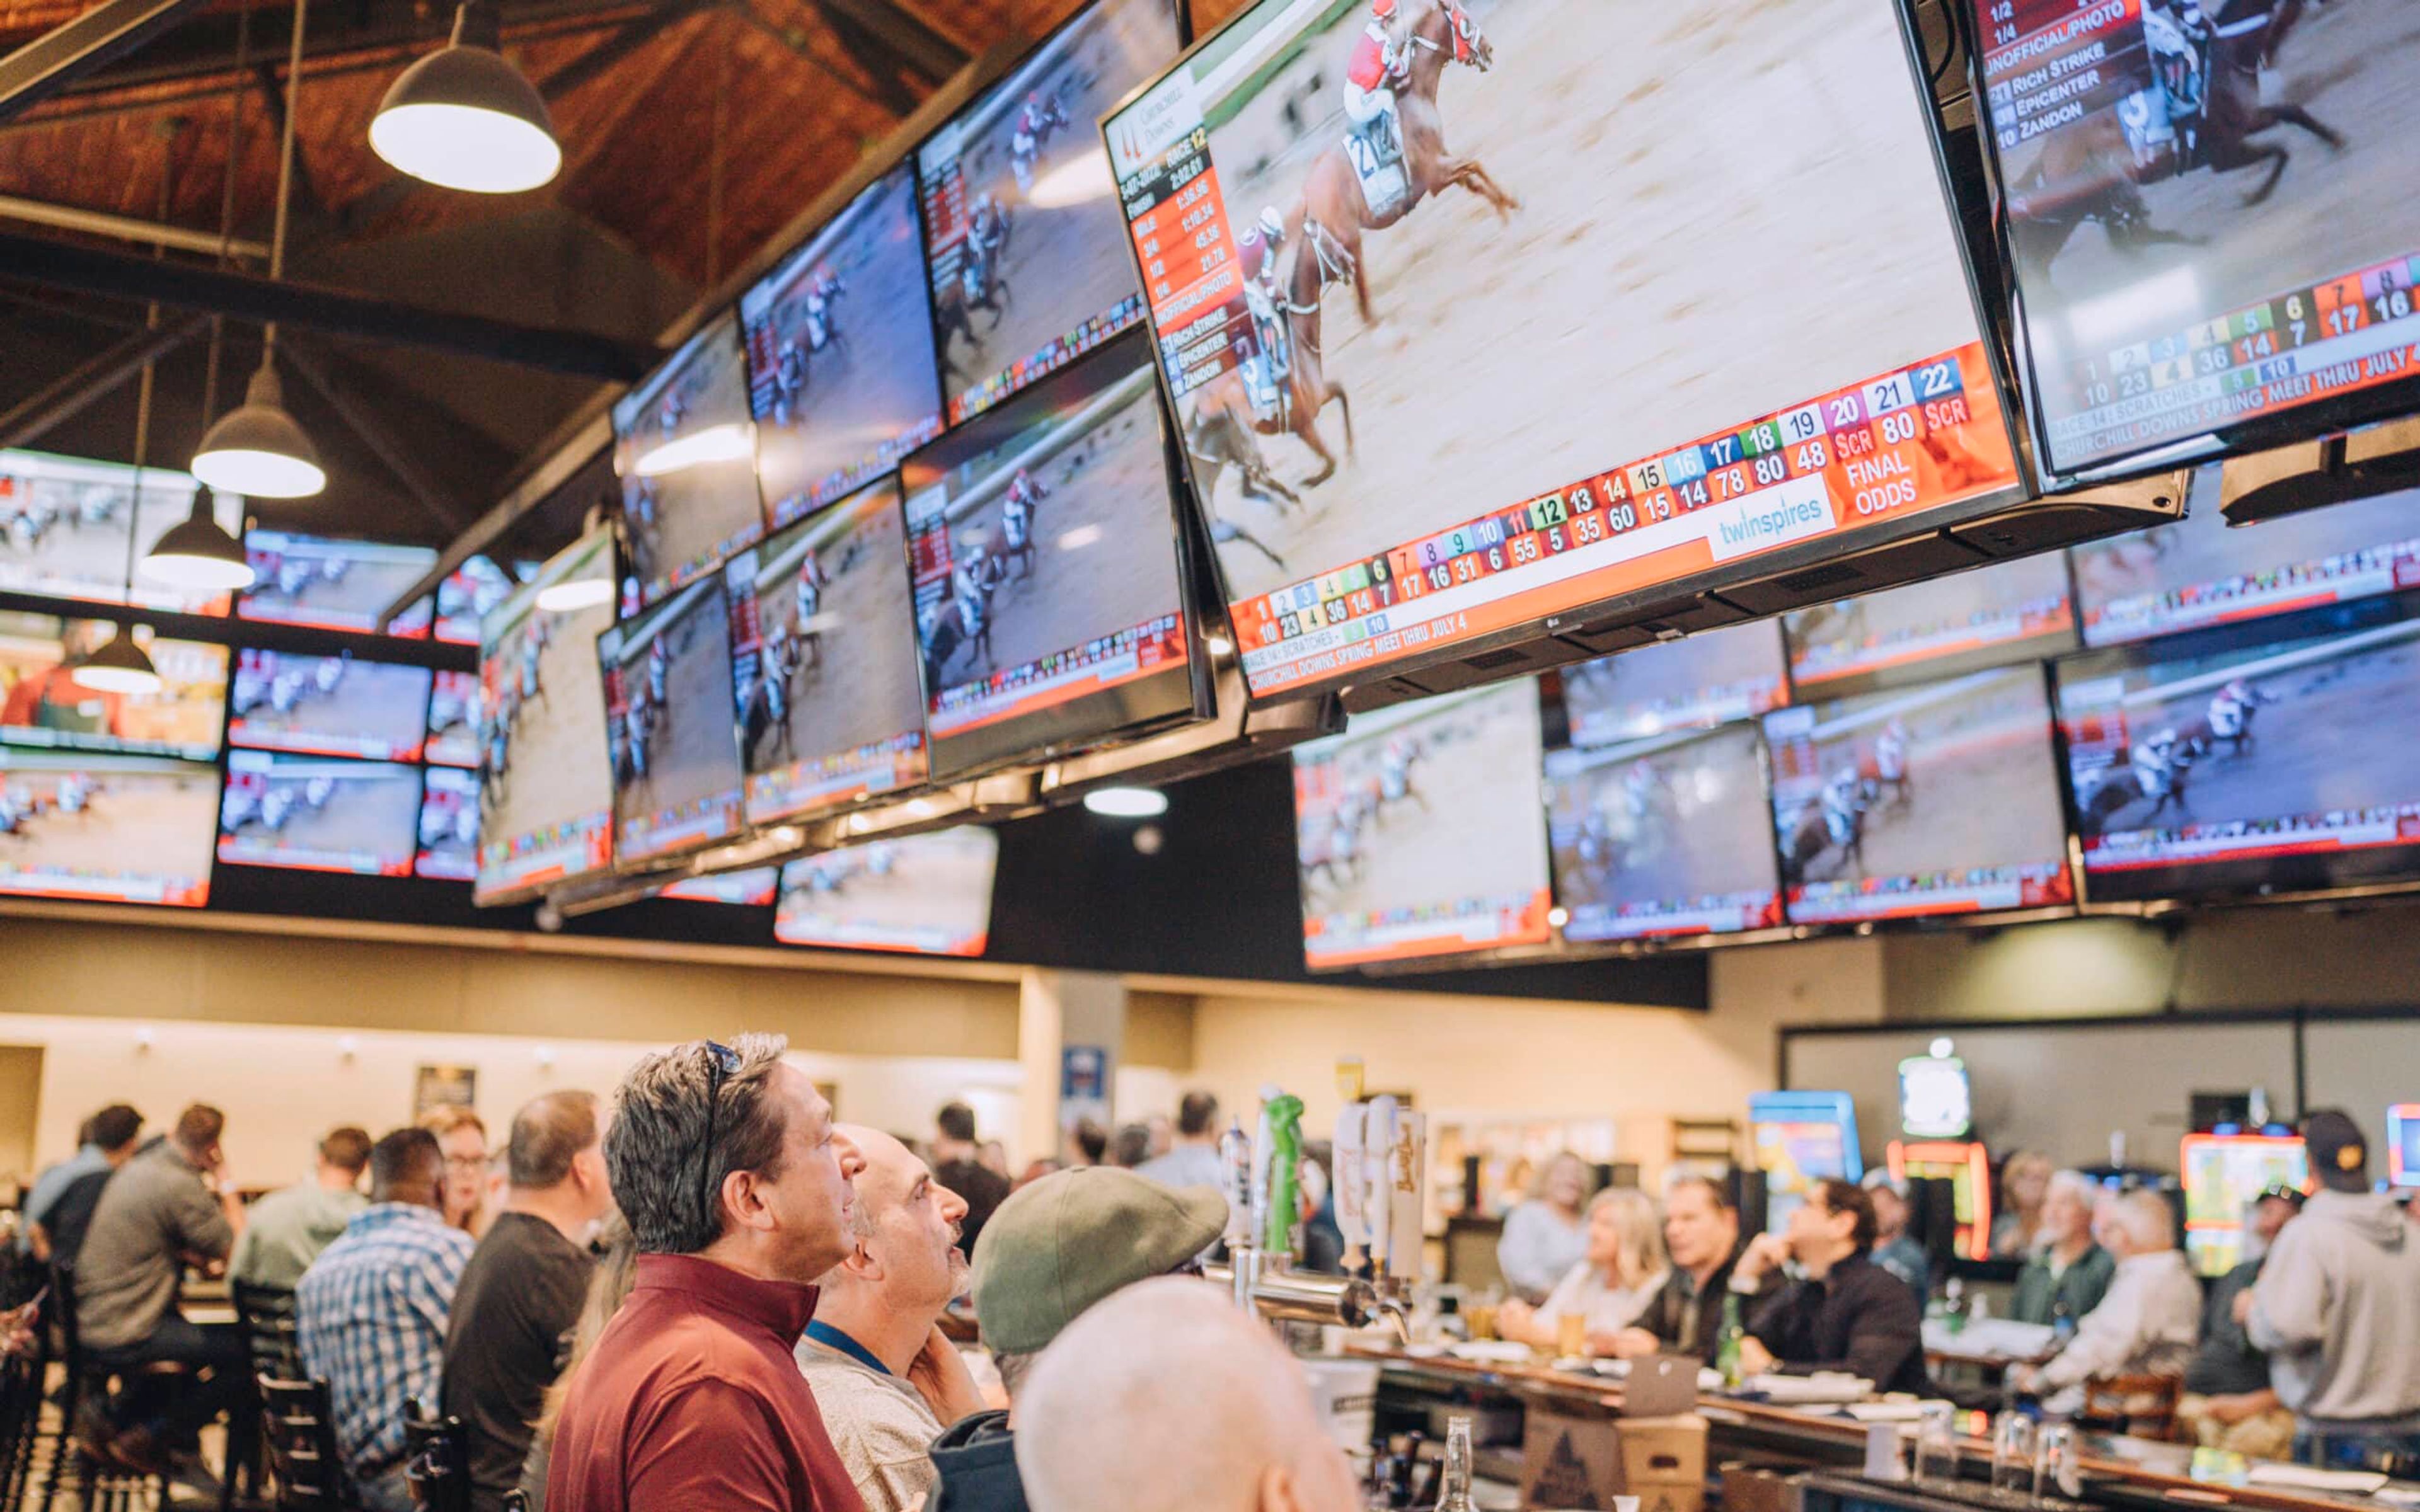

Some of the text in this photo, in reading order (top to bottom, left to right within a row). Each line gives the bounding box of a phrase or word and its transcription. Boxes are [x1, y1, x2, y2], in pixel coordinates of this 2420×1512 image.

[1991, 0, 2013, 22] 1/2
[1995, 23, 2016, 45] 1/4
[2012, 69, 2048, 94] RICH
[2050, 42, 2105, 77] STRIKE
[2017, 69, 2100, 117] EPICENTER
[1167, 139, 1192, 168] RACE
[1191, 129, 1206, 149] 12
[1998, 101, 2083, 149] 10 ZANDON
[1170, 156, 1203, 190] 2:02.61
[1173, 326, 1192, 346] RICH
[1193, 306, 1228, 335] STRIKE
[2244, 311, 2257, 333] 5
[2286, 295, 2303, 321] 6
[2335, 285, 2344, 306] 7
[2380, 271, 2394, 294] 8
[1178, 331, 1228, 369] EPICENTER
[2085, 382, 2108, 405] 10
[2121, 371, 2148, 396] 23
[2200, 347, 2228, 373] 36
[2242, 333, 2272, 362] 14
[2290, 321, 2306, 346] 7
[2329, 304, 2359, 335] 17
[2375, 290, 2409, 322] 16
[1185, 359, 1222, 390] ZANDON
[2117, 384, 2200, 418] SCRATCHES
[2272, 361, 2288, 378] 10
[2139, 408, 2199, 435] DOWNS
[2204, 387, 2264, 418] SPRING
[2269, 373, 2312, 403] MEET
[2312, 358, 2360, 391] THRU
[2366, 347, 2407, 377] JULY
[1257, 600, 1266, 620] 1
[1279, 595, 1289, 612] 2
[1301, 586, 1311, 605] 3
[1327, 579, 1334, 595] 4
[1373, 559, 1386, 581] 6
[1399, 552, 1407, 571] 7
[1426, 543, 1437, 562] 8
[1453, 534, 1464, 553] 9
[1478, 521, 1497, 544] 10
[1509, 511, 1526, 534] 11
[1538, 500, 1560, 524] 12
[1570, 488, 1593, 513] 13
[1603, 476, 1626, 503] 14
[1639, 465, 1660, 490] 15
[1674, 452, 1697, 478] 16
[1710, 438, 1732, 466] 17
[1749, 425, 1774, 454] 18
[1790, 411, 1814, 438] 19
[1830, 396, 1858, 426] 20
[1875, 381, 1903, 410] 21
[1920, 364, 1952, 398] 22
[1847, 450, 1910, 488] FINAL
[1720, 493, 1822, 545] twinspires
[1855, 479, 1916, 515] ODDS
[1260, 399, 1967, 644] 10 23 4 36 14 7 17 16 31 6 55 5 35 60 15 14 78 80 48 SCR 80 SCR
[1371, 617, 1384, 633] 10
[1248, 614, 1466, 690] CHURCHILL DOWNS SPRING MEET THRU JULY 4
